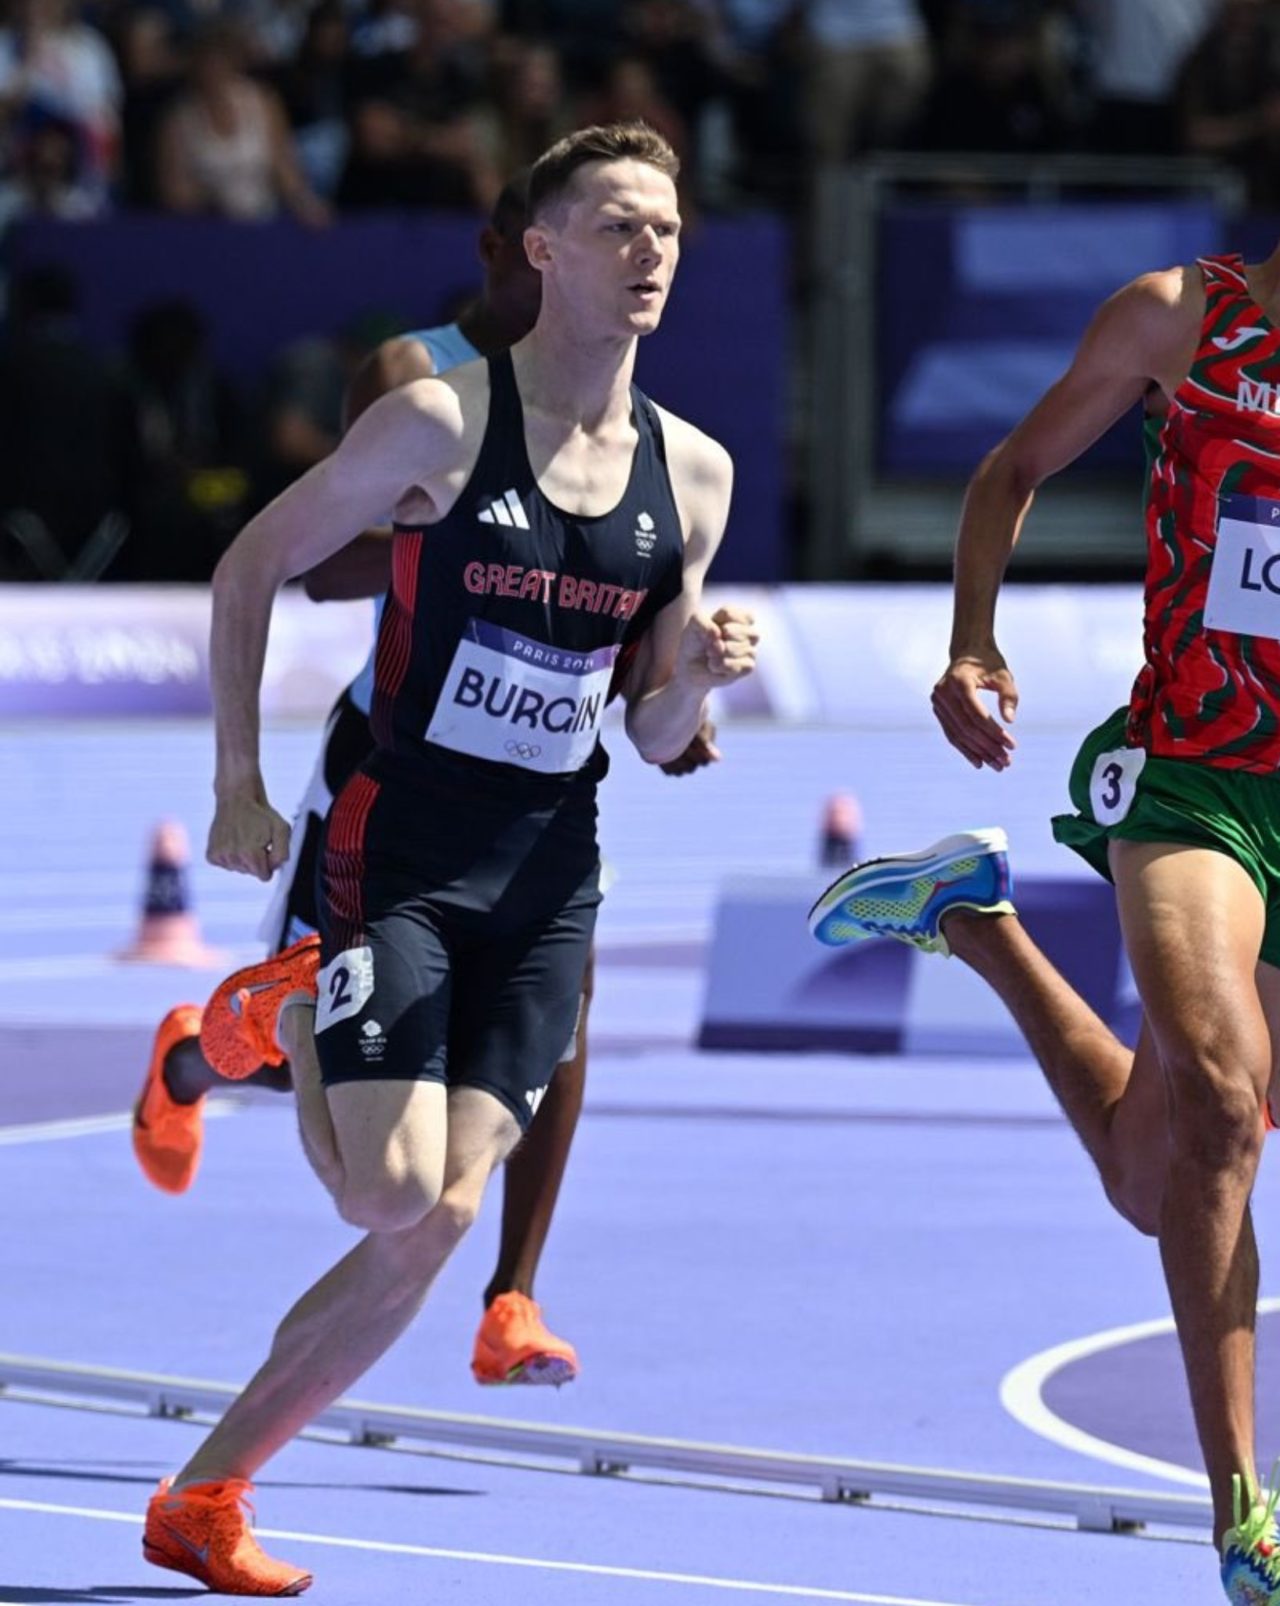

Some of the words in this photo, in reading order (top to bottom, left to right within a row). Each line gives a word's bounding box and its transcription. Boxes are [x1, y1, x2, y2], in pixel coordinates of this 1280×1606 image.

[463, 561, 555, 604] GREAT
[513, 640, 559, 666] PARIS
[452, 667, 601, 734] BURGIN
[1101, 762, 1123, 810] 3
[329, 966, 352, 1014] 2
